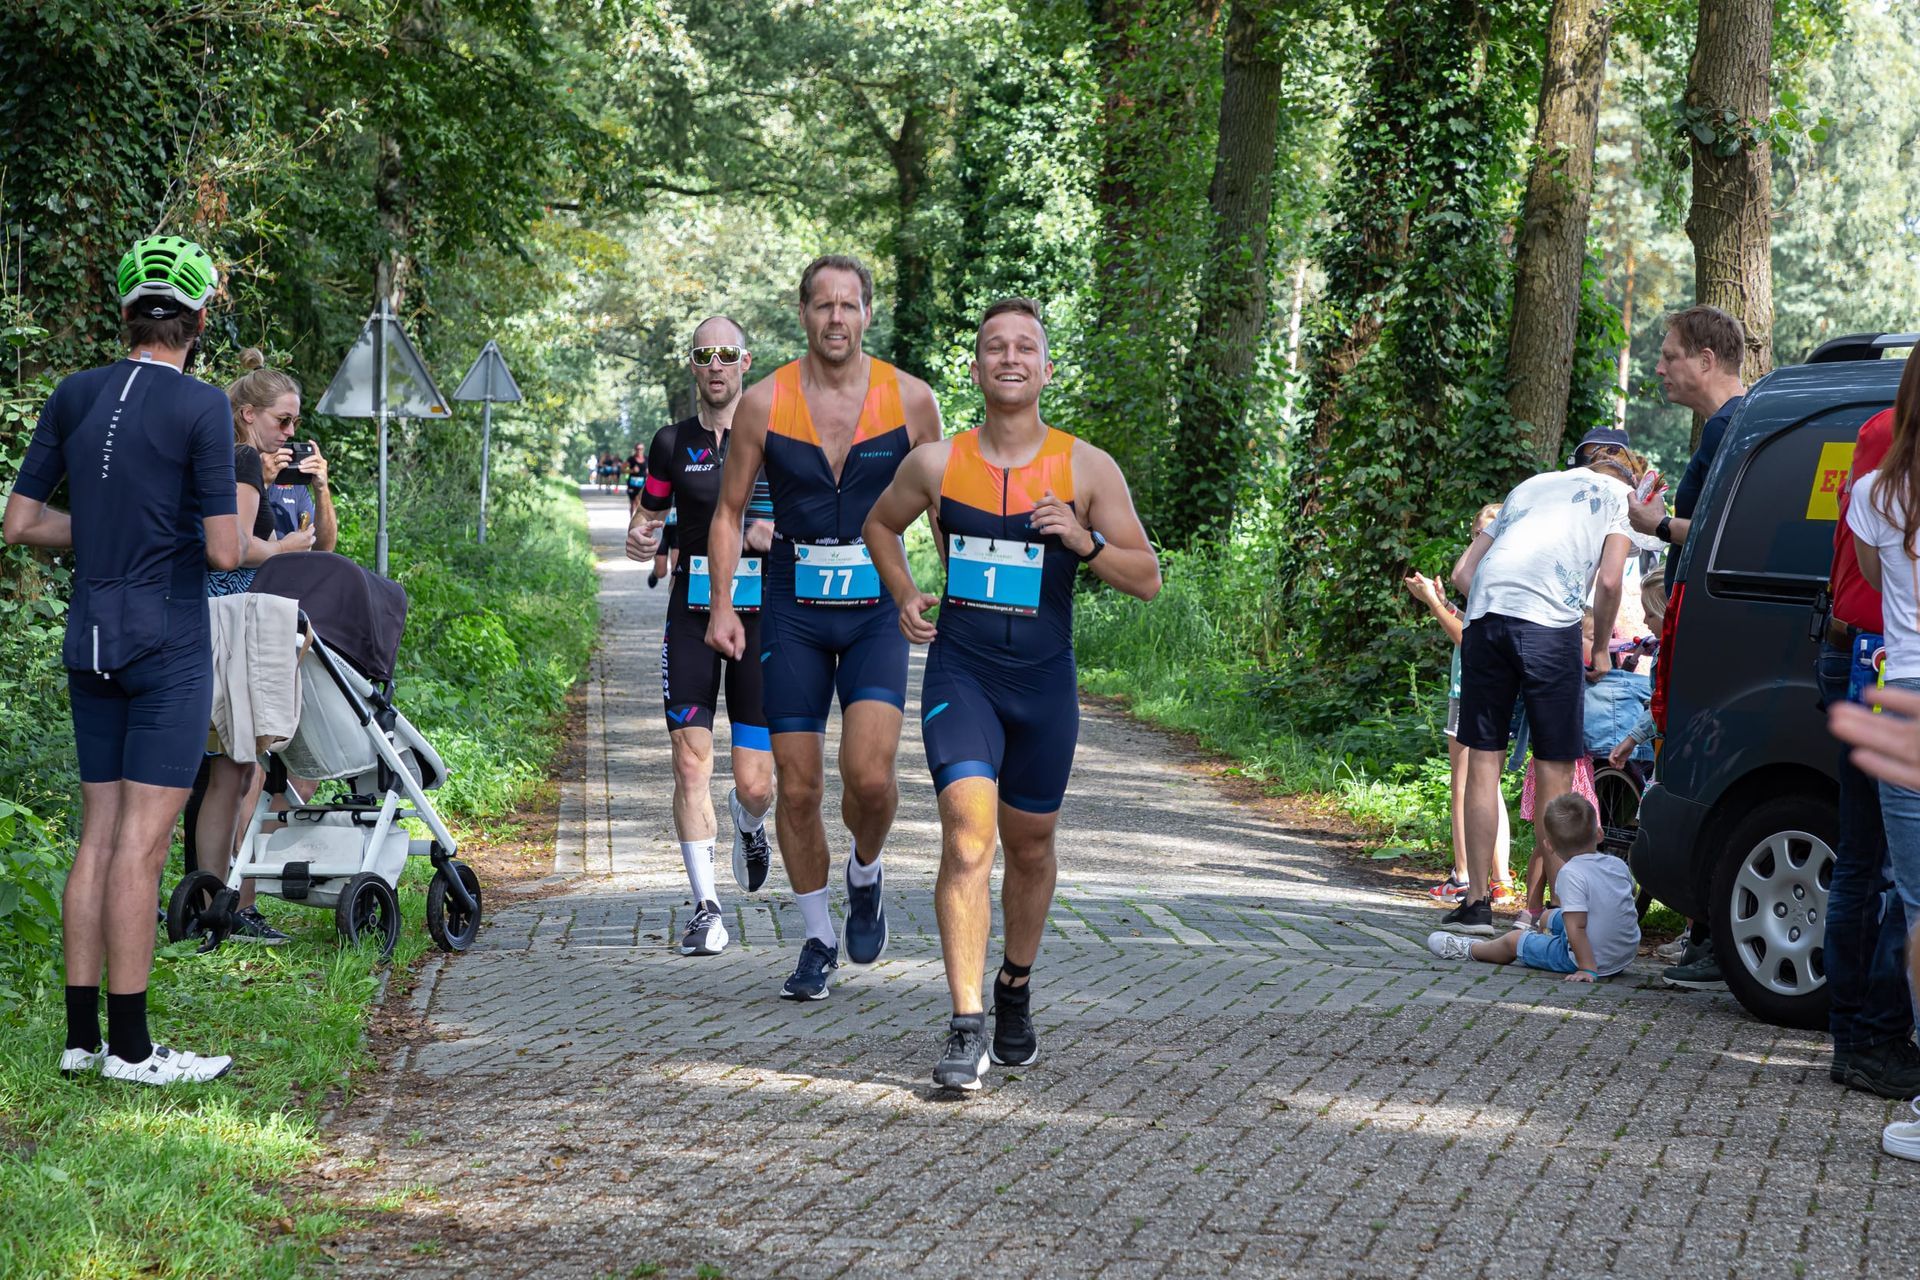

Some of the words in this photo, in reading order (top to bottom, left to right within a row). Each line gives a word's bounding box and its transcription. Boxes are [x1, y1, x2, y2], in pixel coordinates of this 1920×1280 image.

[684, 464, 714, 473] WOEST
[815, 537, 840, 546] sailfish
[818, 568, 853, 596] 77
[983, 566, 996, 598] 1
[661, 642, 672, 700] WOEST
